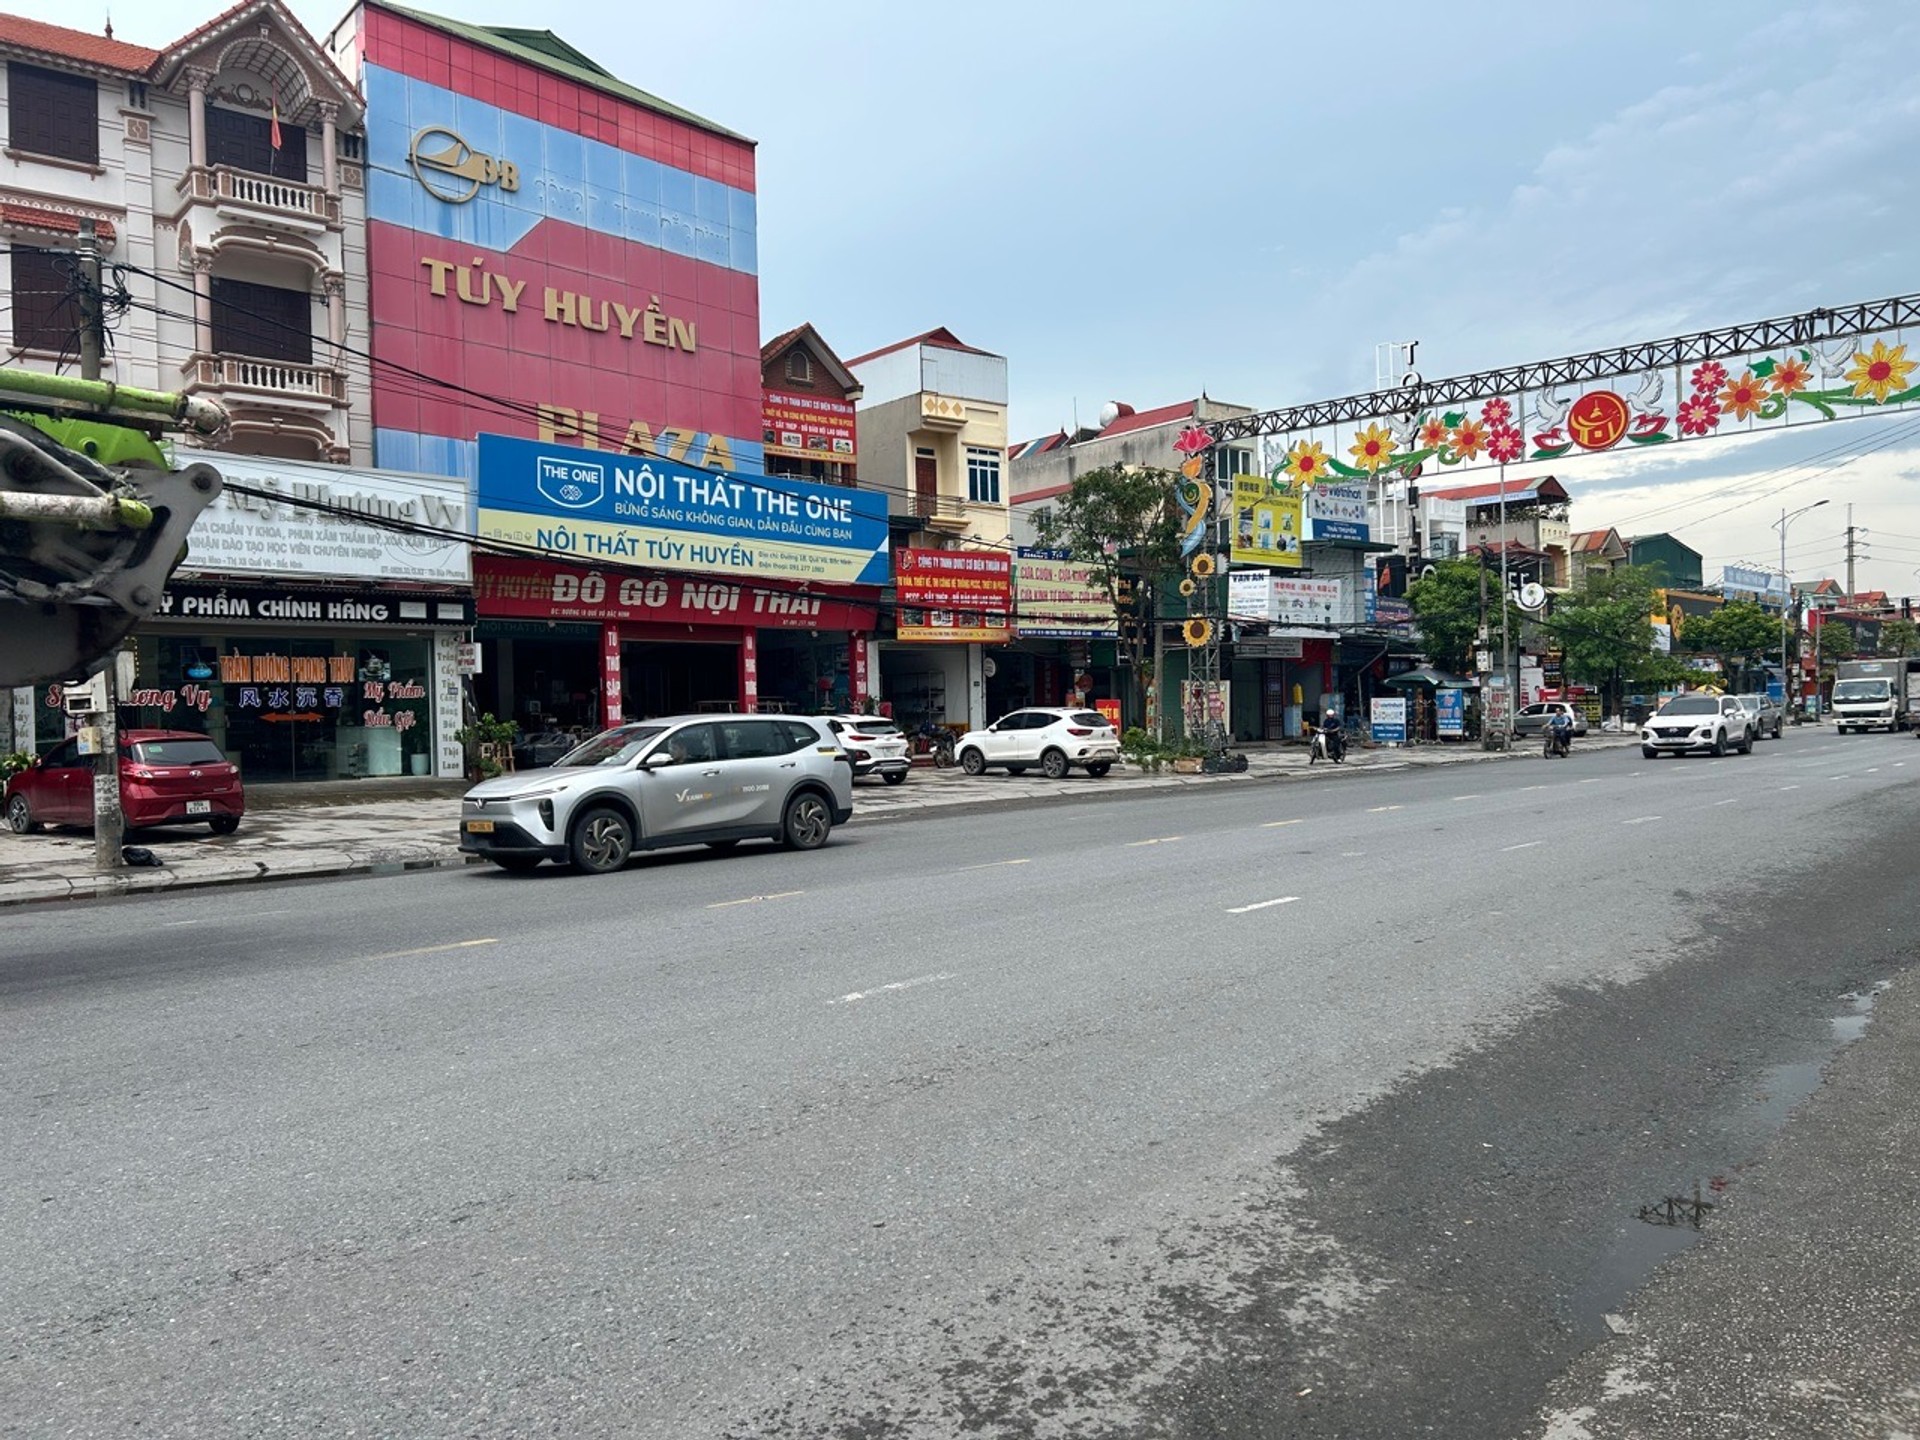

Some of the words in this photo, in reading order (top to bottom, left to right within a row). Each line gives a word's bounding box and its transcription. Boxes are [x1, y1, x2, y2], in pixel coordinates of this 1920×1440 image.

[421, 256, 526, 313] TÚY
[543, 294, 697, 353] HUYỀN
[543, 464, 568, 480] THE
[572, 469, 599, 484] ONE
[615, 463, 664, 505] NỘI
[673, 472, 745, 509] THẤT
[752, 486, 799, 517] THE
[806, 495, 852, 523] ONE
[615, 499, 648, 517] BỪNG
[651, 502, 682, 521] SÁNG
[686, 509, 724, 526] KHÔNG
[727, 518, 755, 531] GIAN,
[758, 515, 780, 532] DẪN
[804, 522, 830, 538] CÙNG
[833, 529, 852, 541] BẠN
[584, 529, 639, 557] THẤT
[646, 535, 685, 561] TÚY
[182, 589, 251, 617] PHẨM
[257, 596, 322, 619] CHÍNH
[328, 600, 389, 621] HÃNG
[220, 647, 250, 684] TRẦM
[291, 655, 327, 684] PHONG
[180, 683, 213, 712] Vy
[239, 687, 344, 709] 风水沉香
